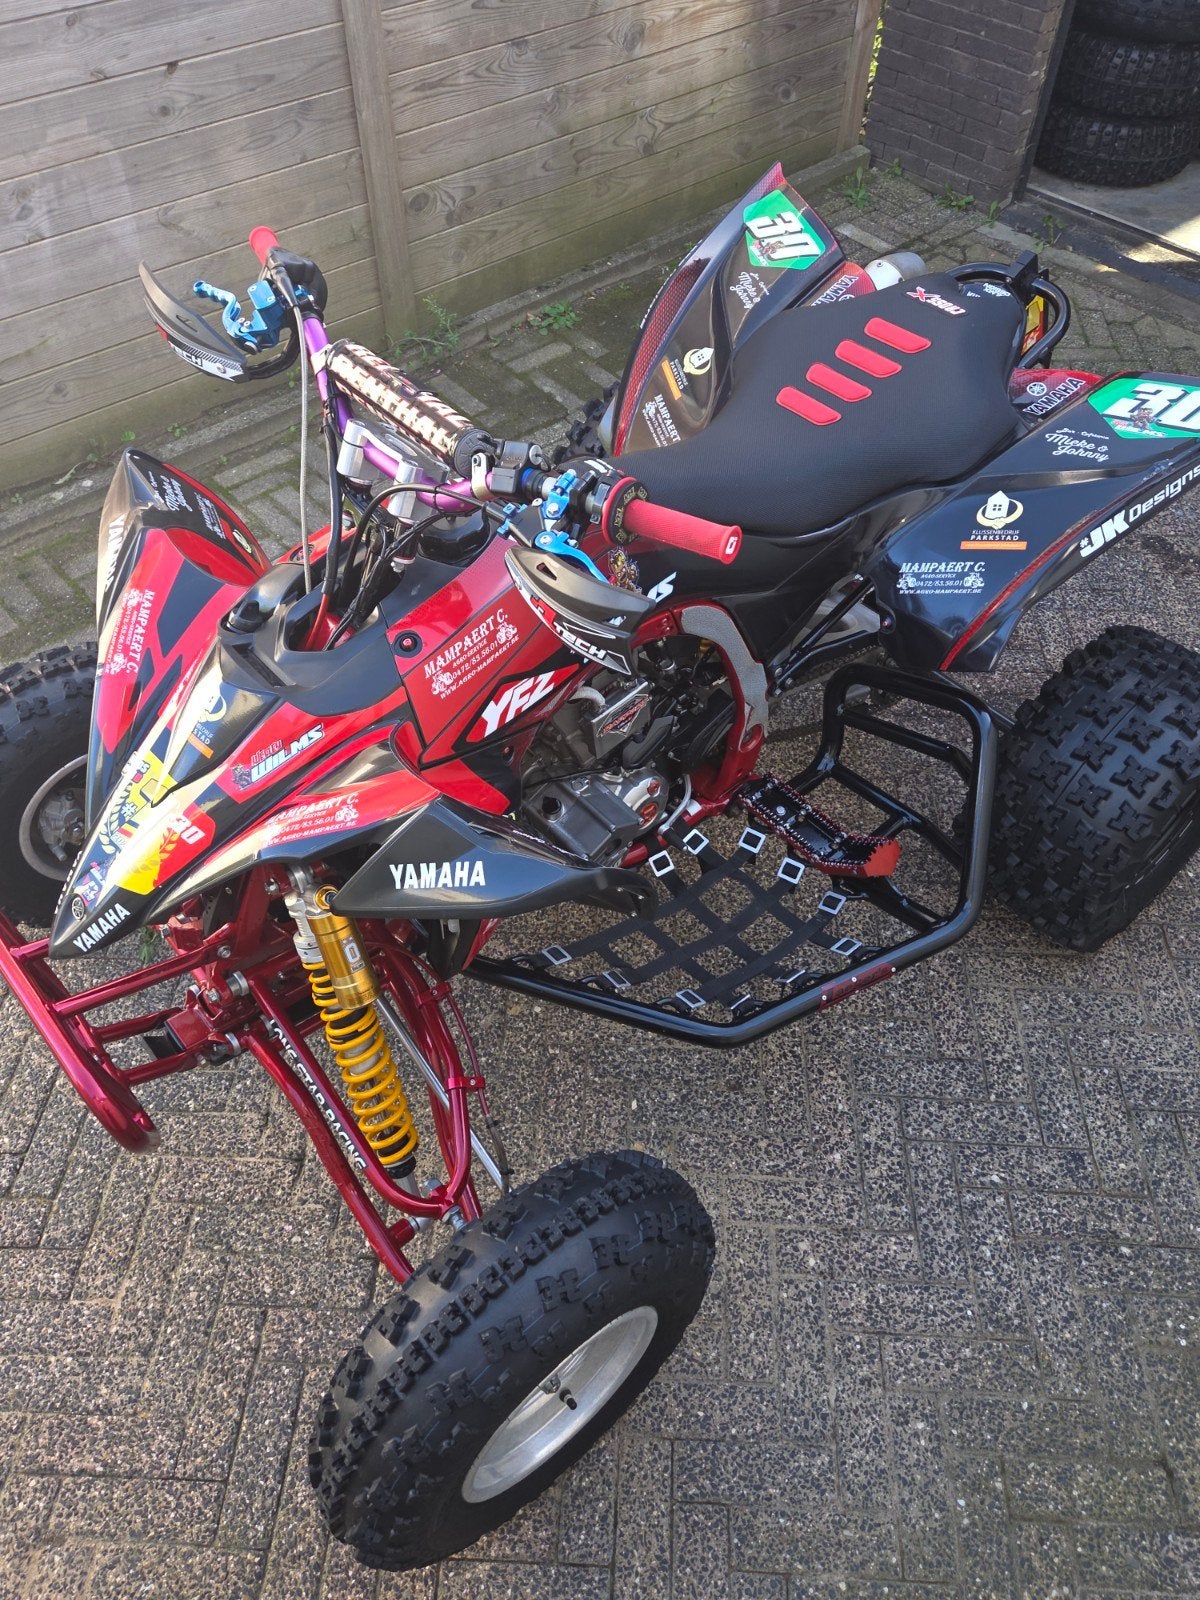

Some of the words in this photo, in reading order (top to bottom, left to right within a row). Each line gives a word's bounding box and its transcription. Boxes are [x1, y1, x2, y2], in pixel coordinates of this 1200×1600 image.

[1022, 376, 1087, 416] YAMAHA
[1045, 432, 1096, 451] Mieke
[1052, 444, 1110, 463] Johnny
[970, 534, 1020, 542] PARKSTAD
[898, 561, 975, 574] MAMPAERT
[973, 561, 987, 573] C.
[129, 589, 156, 662] MAMPAERT
[423, 615, 495, 680] MAMPAERT
[496, 607, 509, 624] C.
[481, 670, 556, 738] YFZ
[388, 860, 487, 890] YAMAHA
[73, 902, 132, 953] YAMAHA
